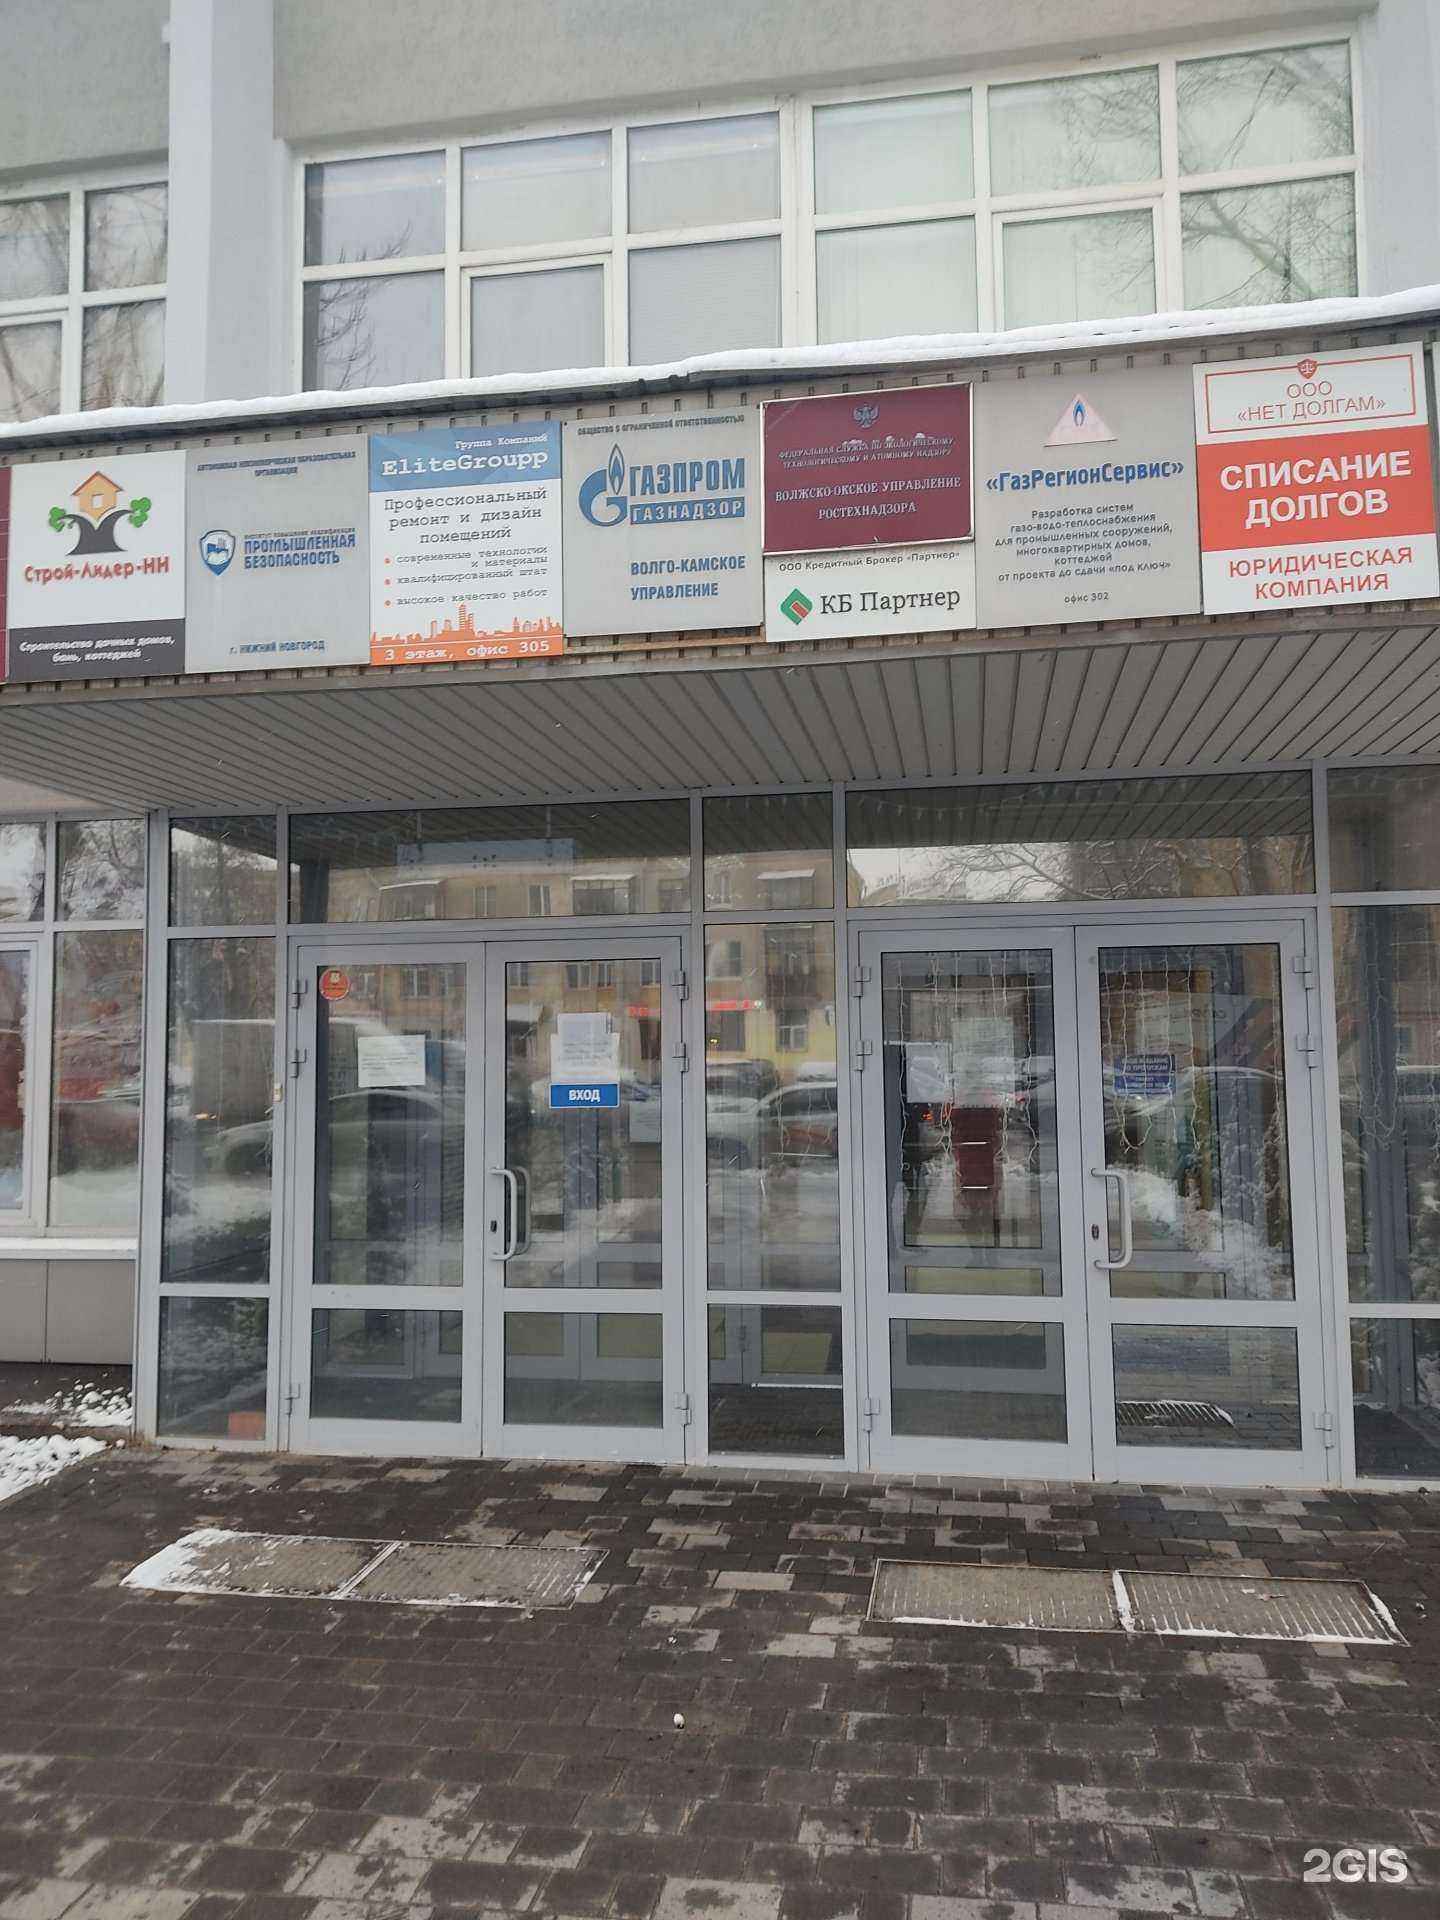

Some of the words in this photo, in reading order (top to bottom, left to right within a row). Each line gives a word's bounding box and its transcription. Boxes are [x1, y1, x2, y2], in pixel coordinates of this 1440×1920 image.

[1287, 380, 1333, 398] ООО
[1237, 403, 1286, 422] «НЕТ
[1292, 396, 1386, 419] ДОЛГАМ»
[455, 439, 492, 451] Группа
[382, 451, 548, 476] EliteGroupp
[1220, 450, 1412, 491] СПИСАНИЕ
[629, 458, 745, 497] ГАЗПРОМ
[986, 461, 1184, 491] «ГазРегионСервис»
[775, 481, 879, 502] ВОЛЖСКО-ОКСКОЕ
[882, 476, 961, 495] УПРАВЛЕНИЕ
[384, 487, 548, 513] Профессиональный
[1245, 489, 1390, 529] ДОЛГОВ
[389, 514, 449, 531] ремонт
[460, 514, 470, 523] и
[480, 506, 542, 522] дизайн
[632, 500, 743, 523] ГАЗНАДЗОР
[818, 501, 917, 520] РОСТЕХНАДЗОРА
[1031, 506, 1093, 519] Разработка
[1096, 503, 1134, 514] систем
[1010, 513, 1156, 533] газо-водо-теплоснабжения
[244, 534, 356, 554] ПРОМЫШЛЕННАЯ
[419, 526, 512, 544] помещений
[995, 538, 1012, 547] для
[1015, 531, 1100, 546] промышленных
[1102, 522, 1173, 538] сооружений,
[396, 552, 472, 564] современные
[478, 546, 548, 558] технологии
[1016, 543, 1112, 557] многоквартирных
[1114, 539, 1151, 550] домов,
[244, 551, 340, 569] БЕЗОПАСНОСТЬ
[485, 556, 548, 568] материалы
[630, 555, 746, 576] ВОЛГО-КАМСКОЕ
[779, 562, 801, 571] ООО
[805, 558, 863, 571] Кредитный
[865, 554, 903, 566] Брокер
[1054, 553, 1113, 566] коттеджей
[1229, 547, 1413, 578] ЮРИДИЧЕСКАЯ
[24, 556, 170, 585] Строй-Лидер-НН
[519, 568, 548, 577] штат
[998, 573, 1009, 582] от
[1013, 570, 1056, 581] проекта
[1058, 569, 1072, 578] до
[1074, 566, 1106, 577] сдачи
[1109, 564, 1135, 574] «под
[1137, 561, 1171, 571] ключ»
[452, 592, 506, 602] качество
[513, 589, 548, 600] работ
[630, 583, 719, 601] УПРАВЛЕНИЕ
[1255, 574, 1390, 600] КОМПАНИЯ
[820, 593, 852, 614] КБ
[860, 590, 961, 614] Партнер
[1064, 594, 1089, 604] офис
[1091, 592, 1110, 601] 302
[385, 649, 395, 661] 3
[405, 648, 454, 660] этаж,
[466, 644, 510, 657] офис
[519, 640, 550, 653] 305
[568, 1089, 601, 1103] ВХОД
